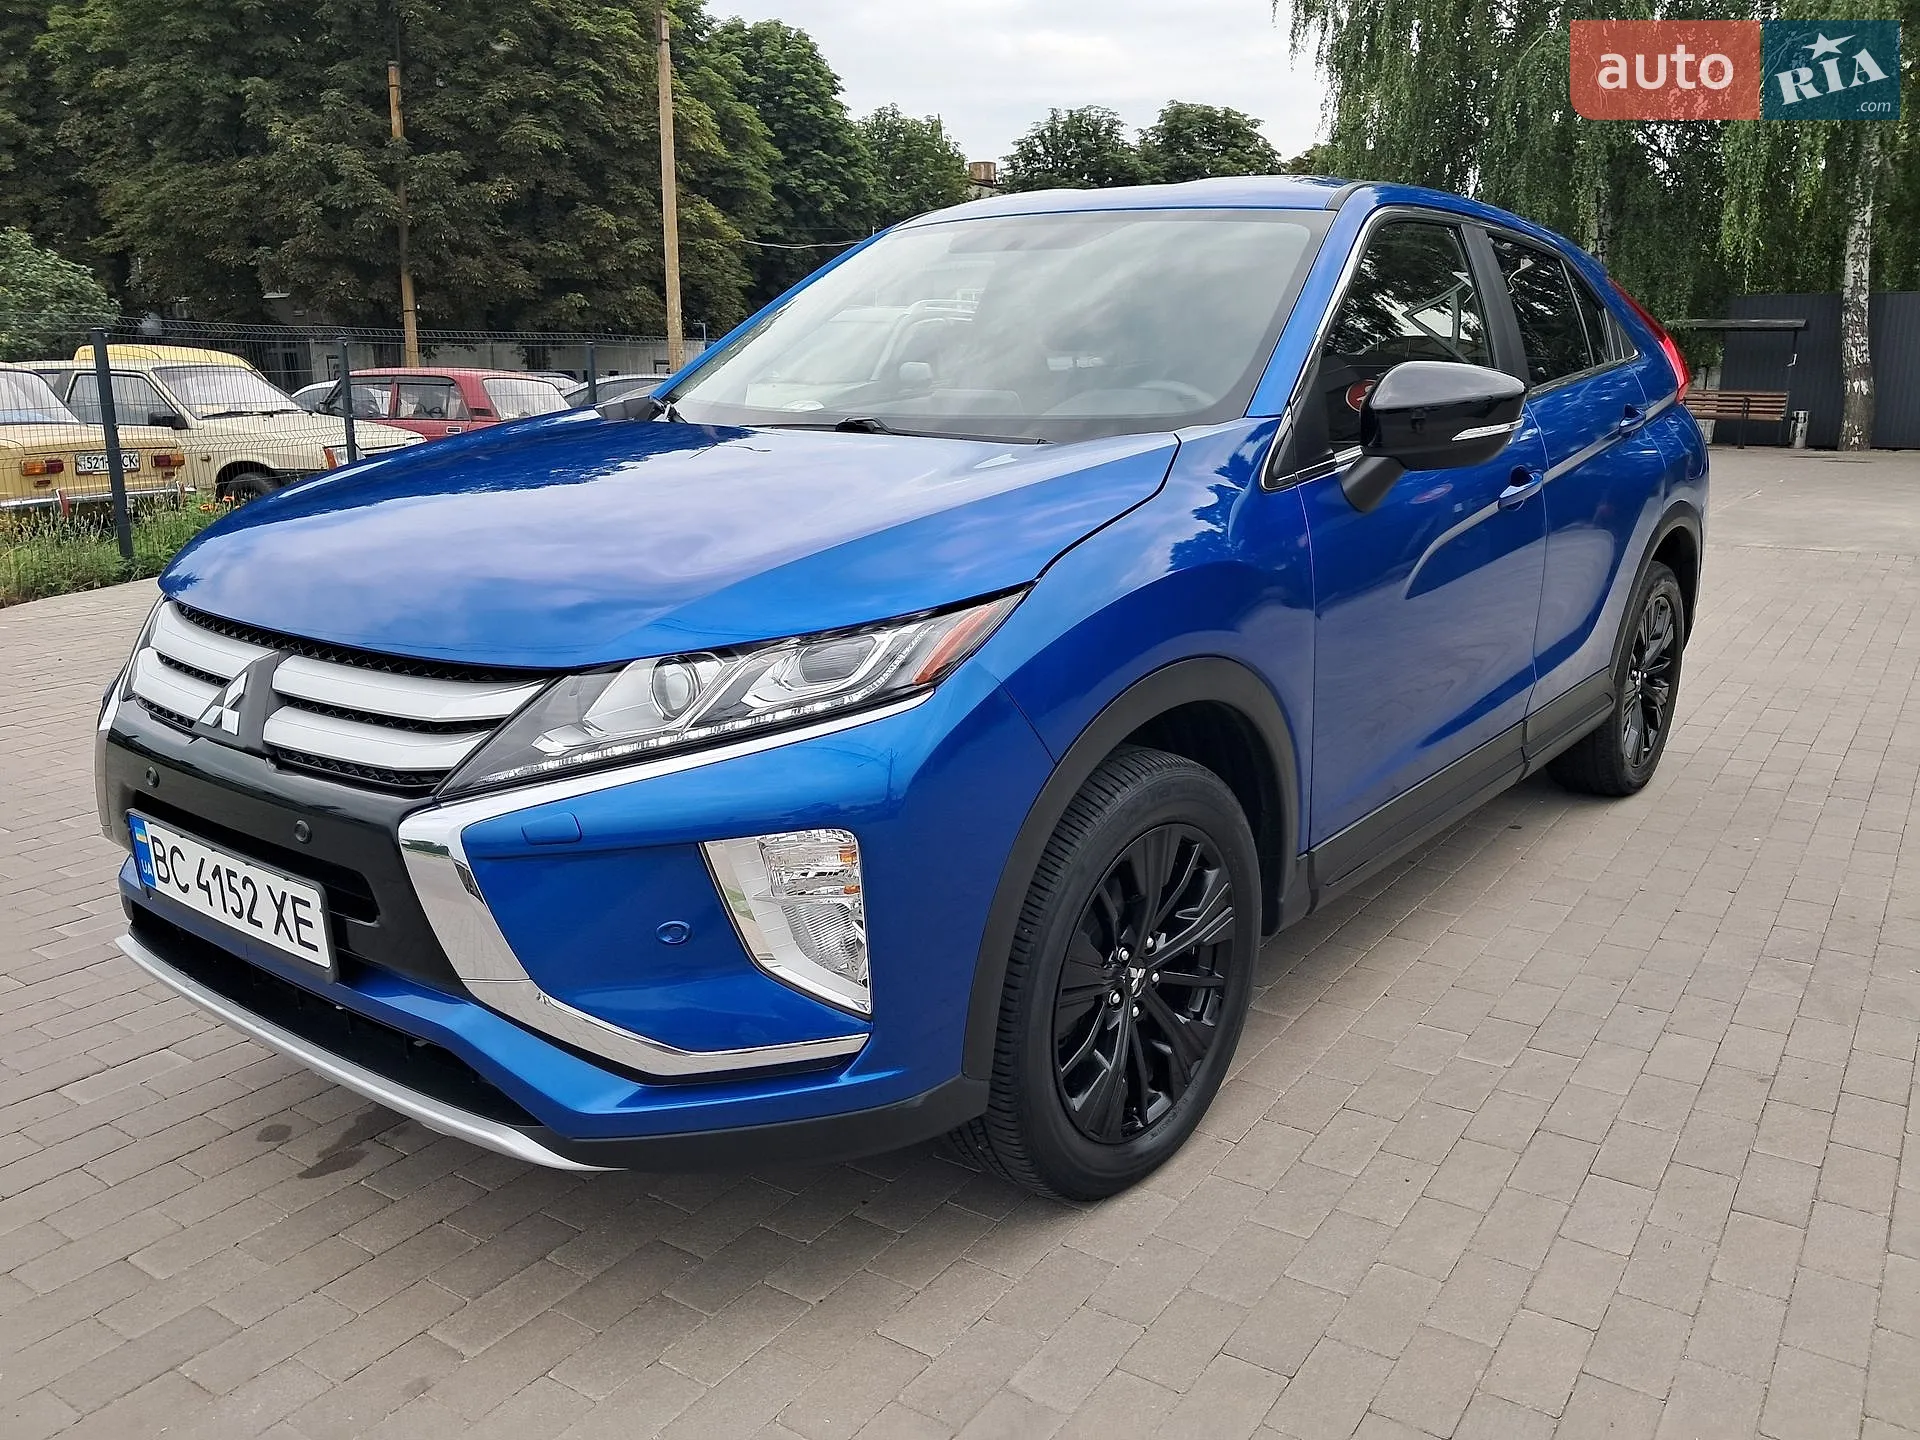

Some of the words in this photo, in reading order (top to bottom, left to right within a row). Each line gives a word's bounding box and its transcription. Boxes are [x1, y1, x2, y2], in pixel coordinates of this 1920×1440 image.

[141, 859, 154, 877] UA
[150, 835, 190, 894] BC
[196, 857, 263, 929] 4152
[266, 885, 319, 953] XE
